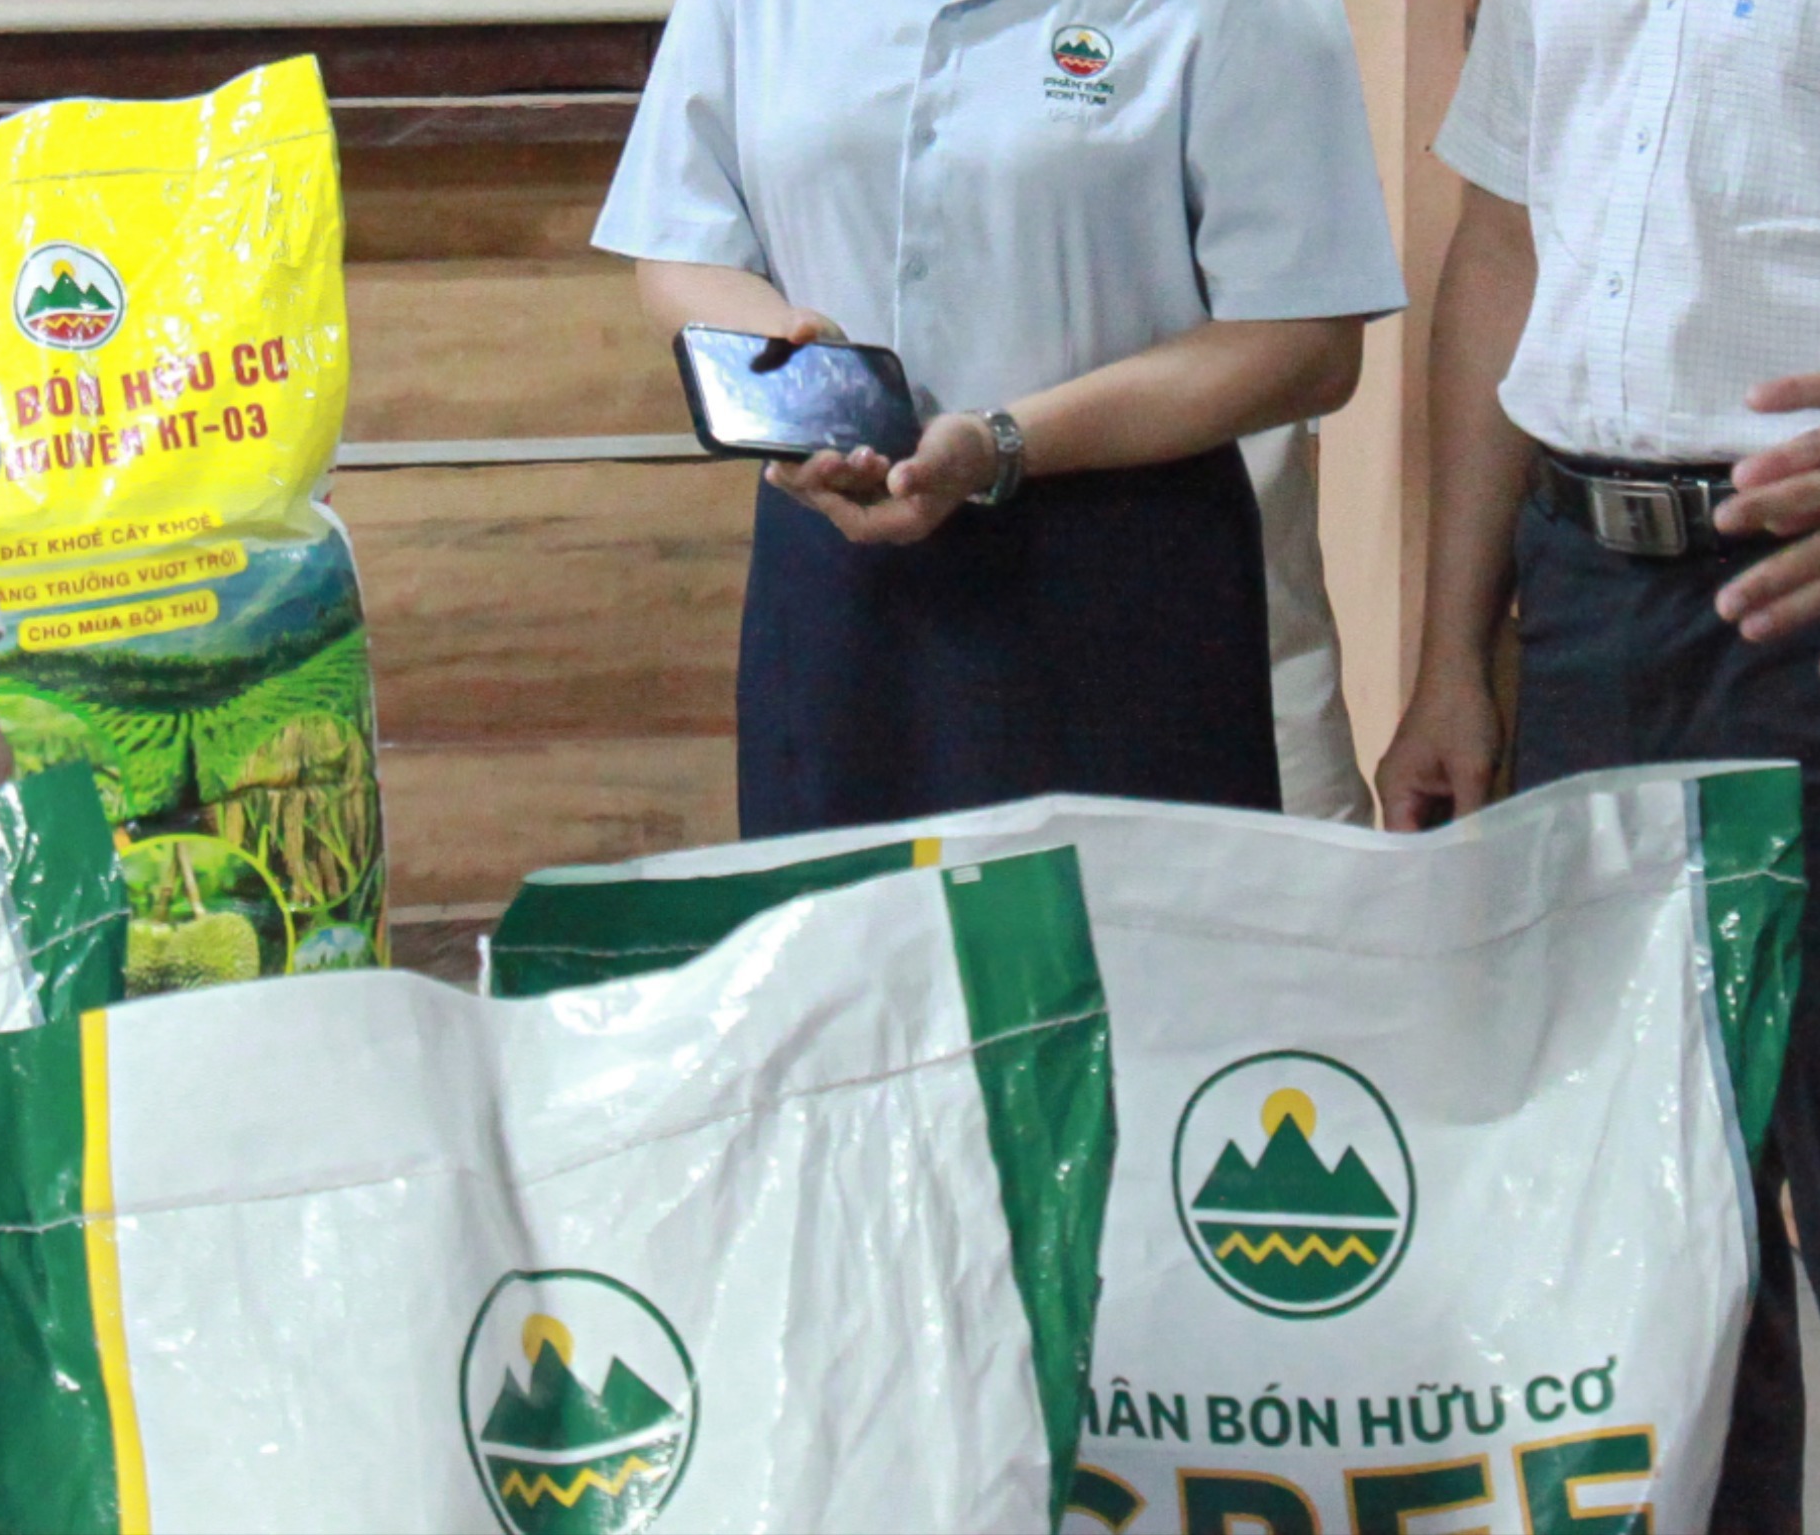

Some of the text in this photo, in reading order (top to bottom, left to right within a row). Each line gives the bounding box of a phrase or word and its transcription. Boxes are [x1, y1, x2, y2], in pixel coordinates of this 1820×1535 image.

[15, 369, 105, 428] BÓN
[232, 336, 289, 386] CƠ
[159, 403, 268, 451] KT-03
[28, 624, 71, 642] CHO
[1083, 1354, 1617, 1447] ÂN BÓN HỮU CƠ
